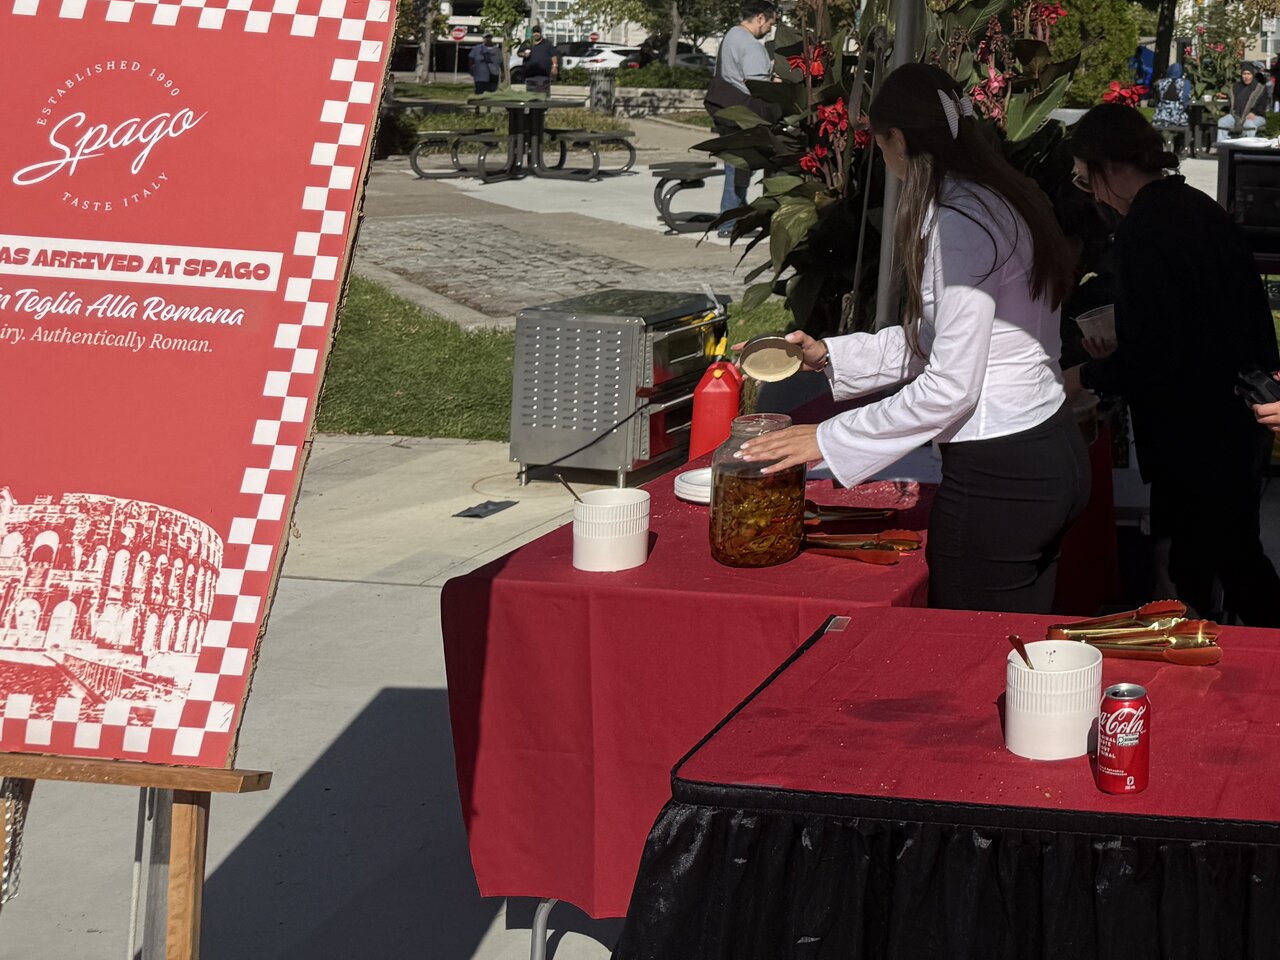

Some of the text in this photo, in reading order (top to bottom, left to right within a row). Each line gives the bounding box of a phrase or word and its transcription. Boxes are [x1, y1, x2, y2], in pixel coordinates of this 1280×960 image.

[37, 60, 181, 126] ESTABLISHED 1990
[12, 107, 209, 186] Spago
[62, 172, 169, 212] TASTE ITALY
[32, 249, 144, 273] ARRIVED
[146, 256, 181, 275] AT
[182, 258, 271, 281] SPAGO
[14, 288, 83, 320] Teglia
[85, 293, 138, 319] Alla
[142, 296, 245, 326] Romana
[30, 326, 145, 352] Authentically
[149, 333, 213, 352] Roman.
